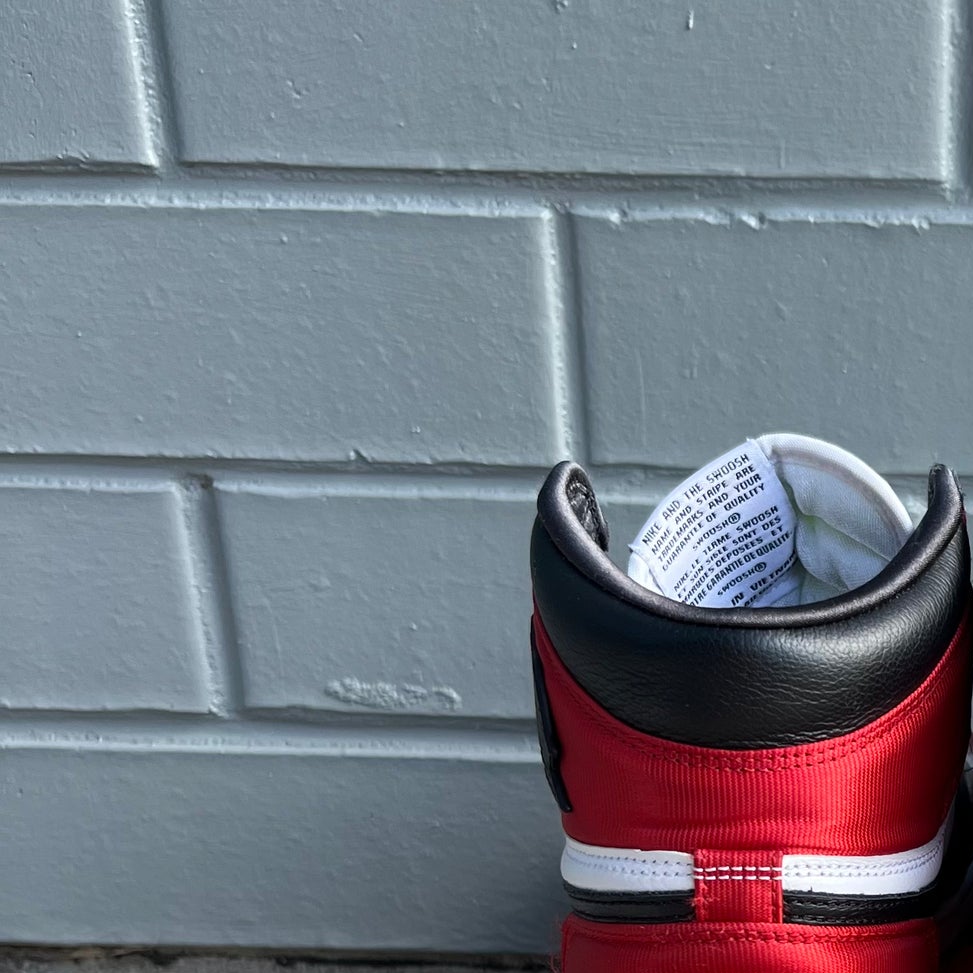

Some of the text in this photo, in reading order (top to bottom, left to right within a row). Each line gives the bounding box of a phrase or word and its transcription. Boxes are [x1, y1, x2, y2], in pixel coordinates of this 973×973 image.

[642, 453, 750, 545] NIKE AND THE SWOOSH
[651, 464, 756, 555] NAME AND STRIPE ARE
[658, 473, 762, 562] TRADEMARKS AND YOUR
[662, 483, 765, 571] GUARANTEE OF QUALITY
[691, 558, 701, 569] LE
[702, 532, 731, 556] TERME
[736, 505, 779, 533] SWOOSH
[677, 515, 782, 599] ET SON SIGLE SONT DES
[706, 557, 744, 591] GARANTIE
[743, 551, 757, 563] DE
[715, 536, 763, 568] DEPOSEES
[771, 524, 784, 536] ET
[731, 592, 744, 606] IN
